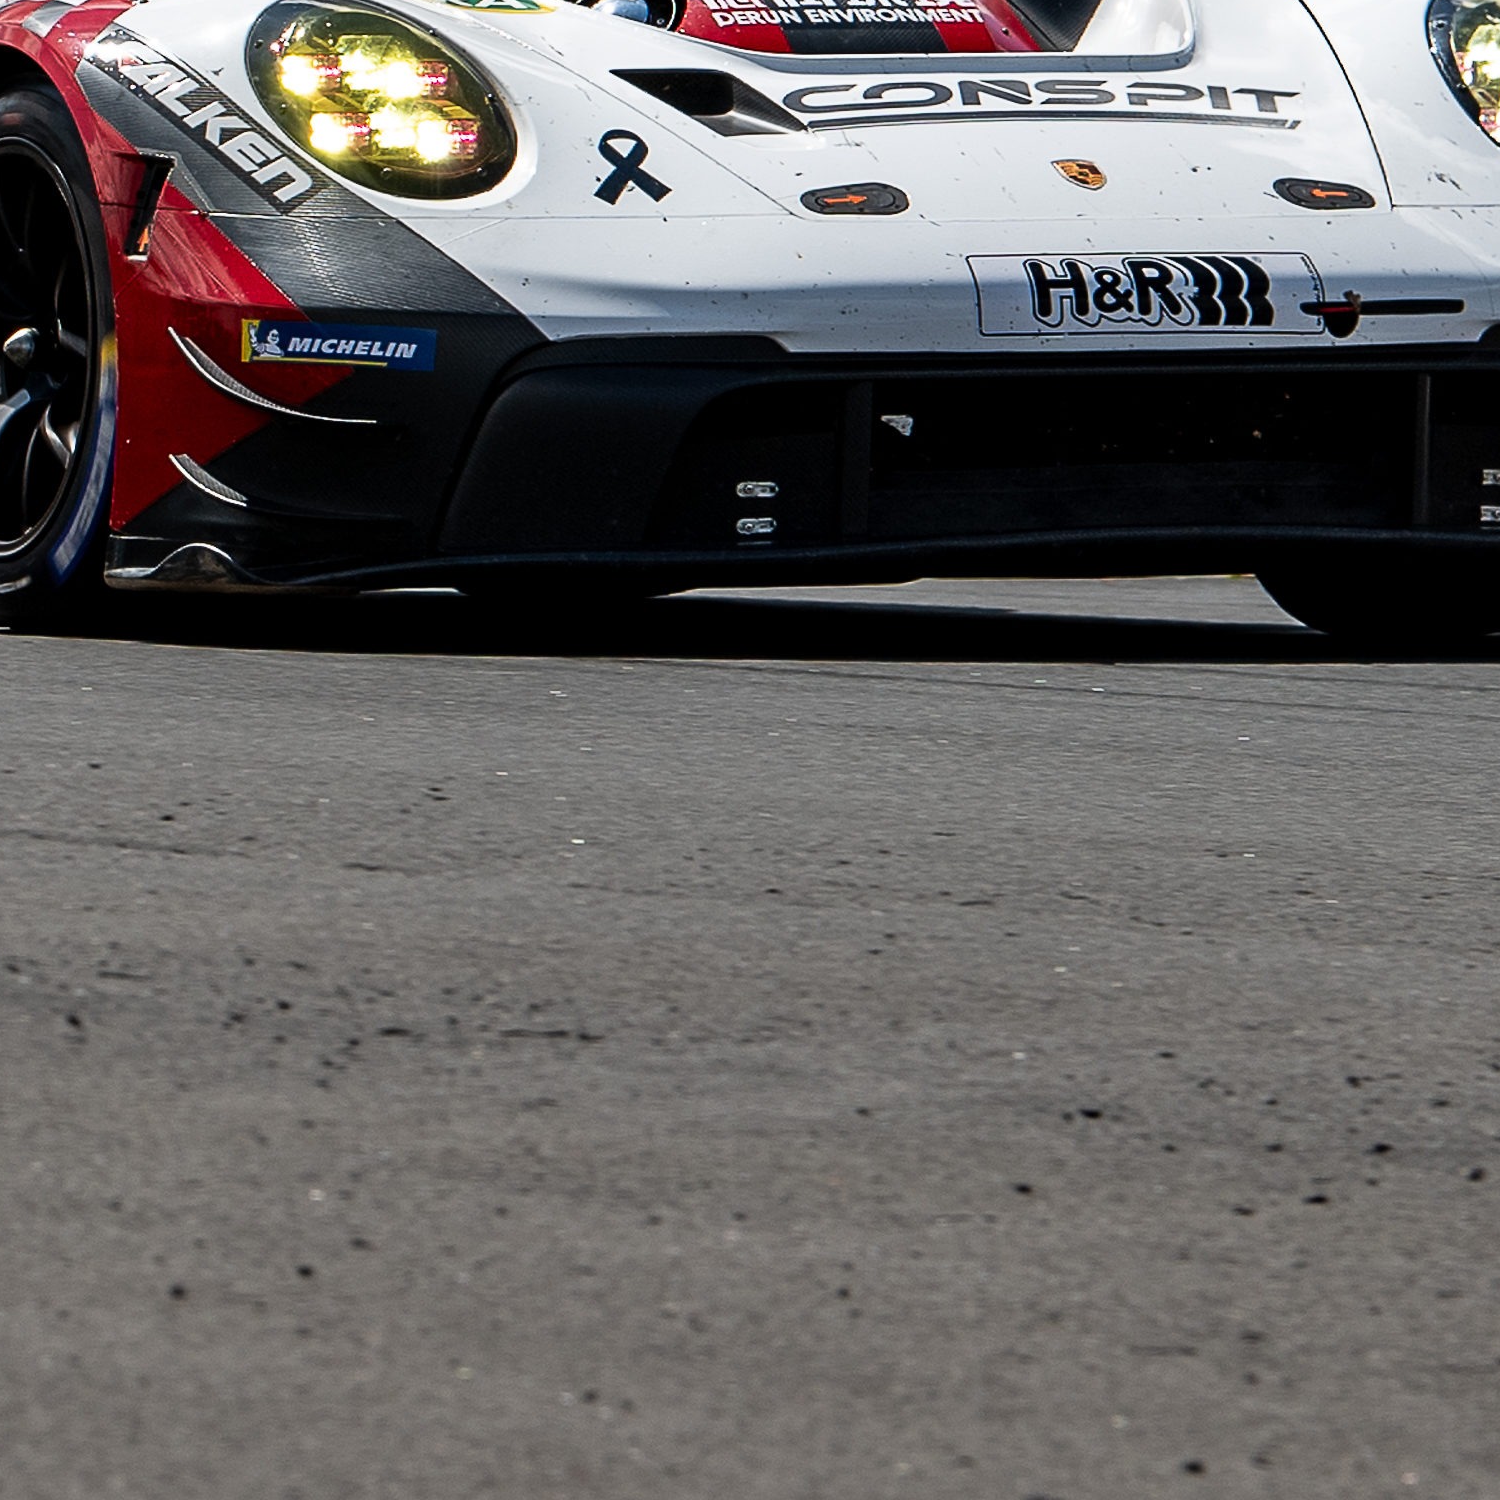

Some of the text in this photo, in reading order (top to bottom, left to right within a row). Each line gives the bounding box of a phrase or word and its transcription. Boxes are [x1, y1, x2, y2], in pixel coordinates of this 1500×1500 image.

[711, 8, 985, 28] DERUN ENVIRONMENT
[782, 79, 1301, 114] CONSPIT
[1025, 259, 1194, 327] H&R
[287, 336, 418, 359] MICHELIN
